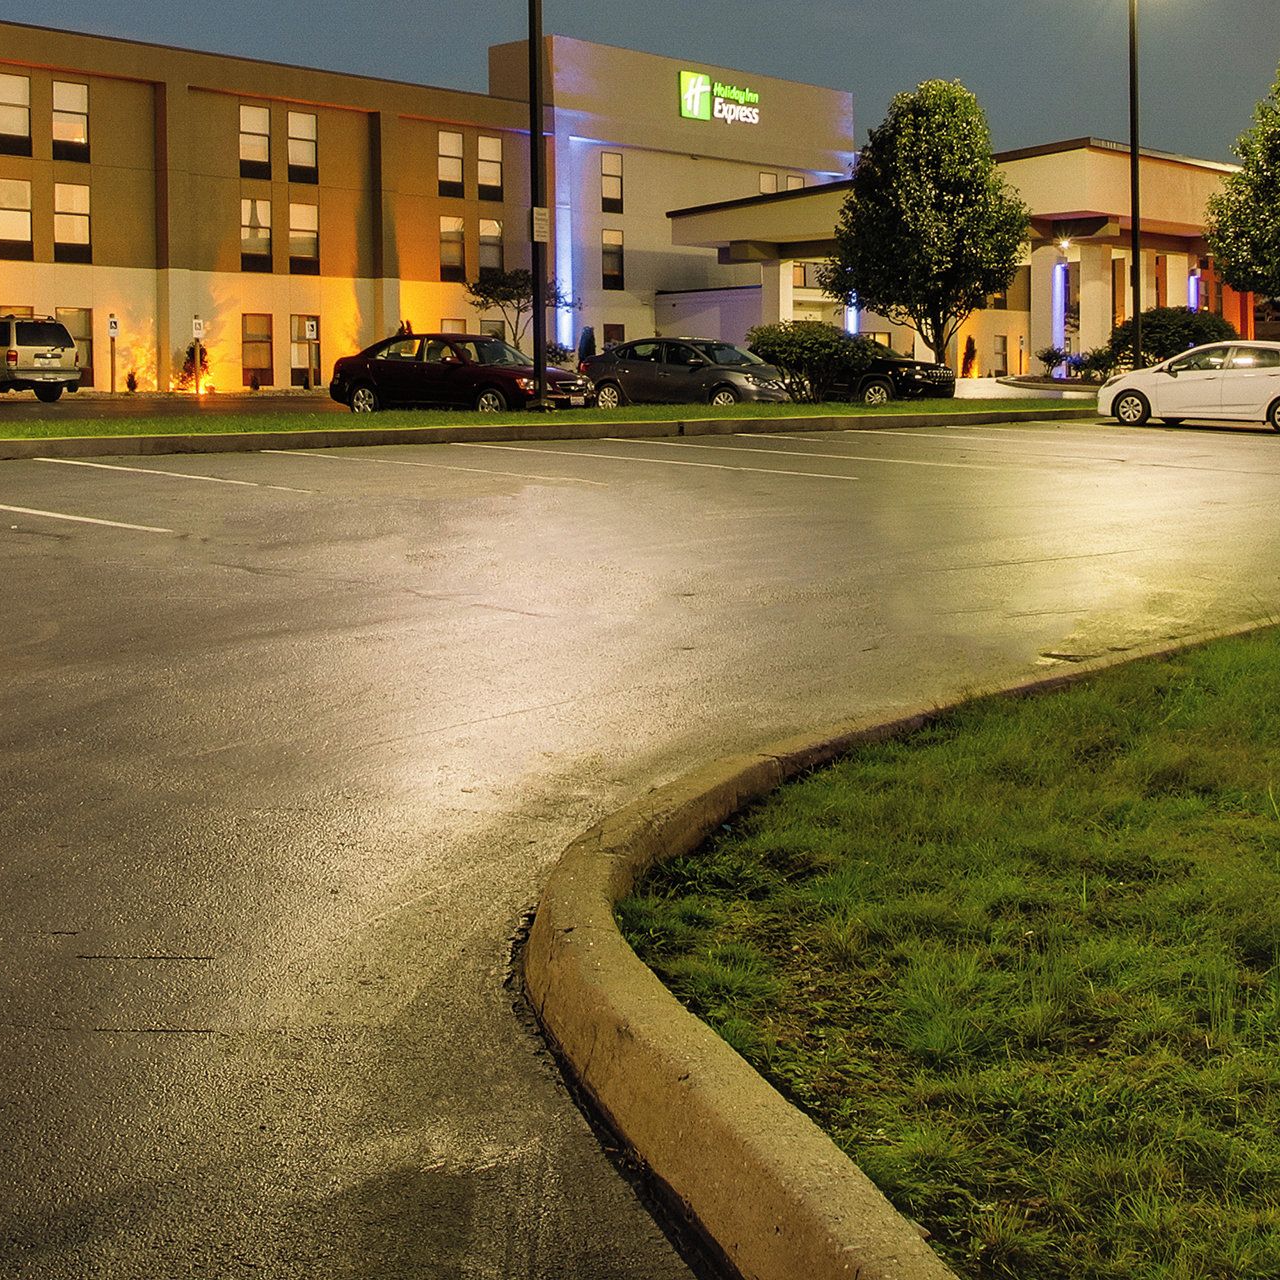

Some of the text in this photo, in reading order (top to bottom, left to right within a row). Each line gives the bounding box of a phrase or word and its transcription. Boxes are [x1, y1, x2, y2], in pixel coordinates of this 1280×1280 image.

[713, 82, 759, 105] Holiday Inn
[713, 97, 760, 124] Express
